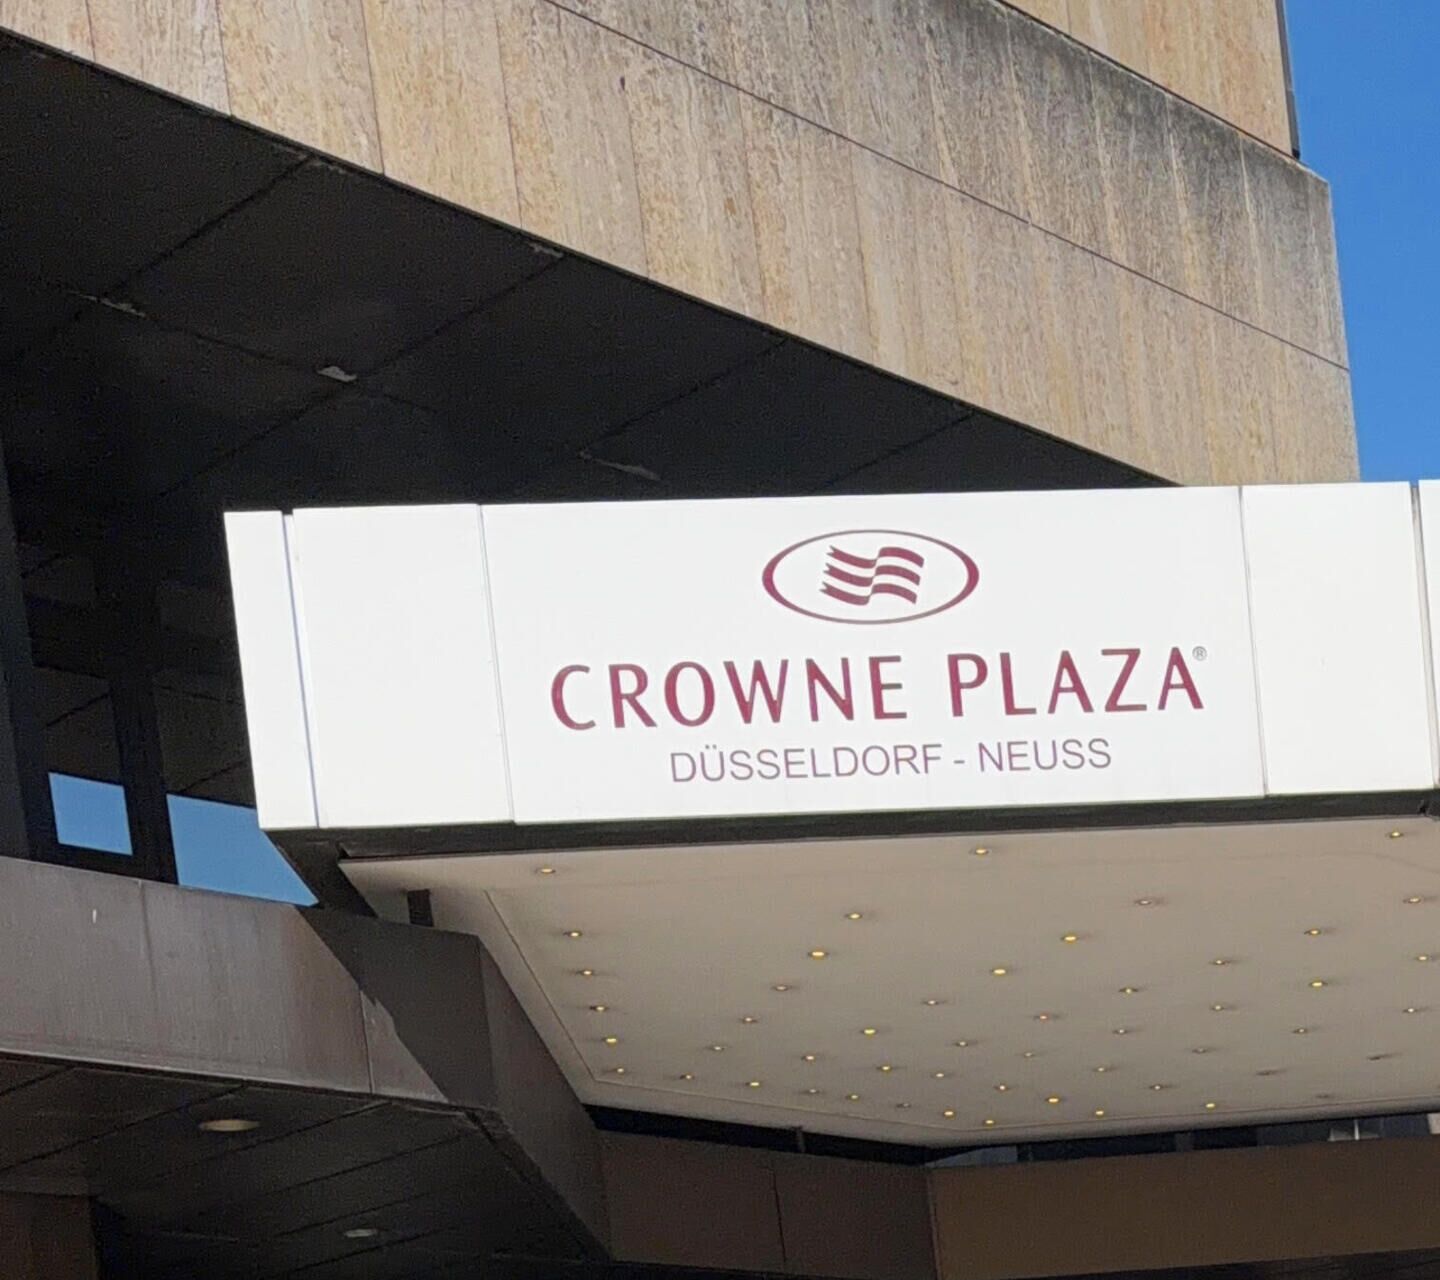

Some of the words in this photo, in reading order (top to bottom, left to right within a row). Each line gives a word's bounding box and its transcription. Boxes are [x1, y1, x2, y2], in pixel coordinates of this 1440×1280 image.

[551, 655, 907, 731] CROWNE
[670, 743, 942, 783] DÜSSELDORF
[978, 737, 1112, 773] NEUSS
